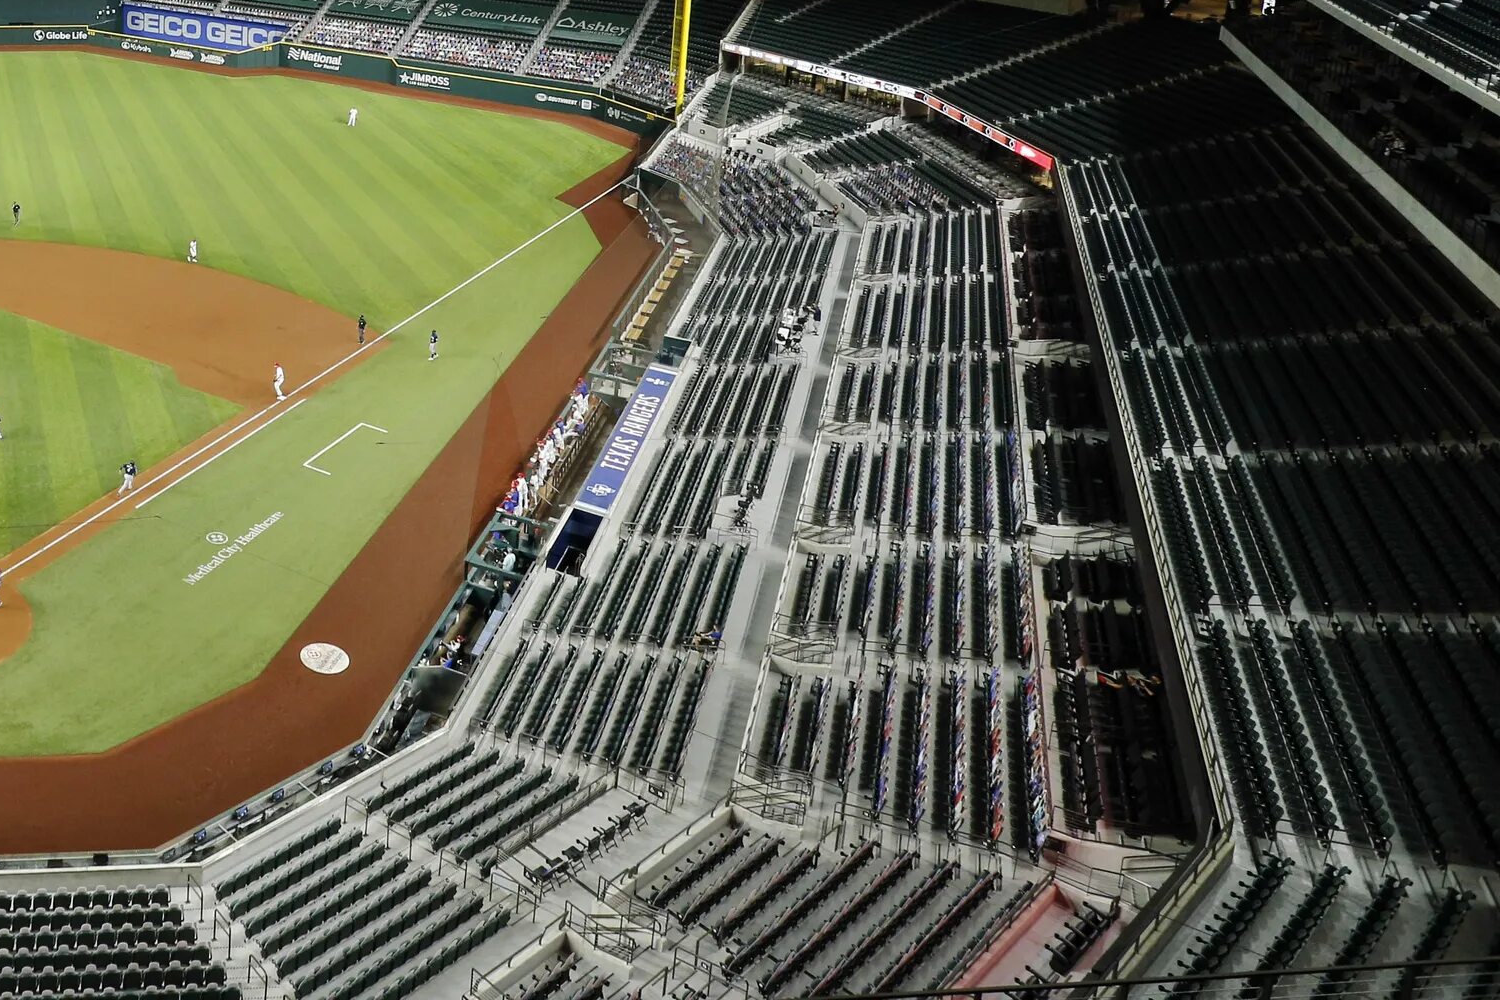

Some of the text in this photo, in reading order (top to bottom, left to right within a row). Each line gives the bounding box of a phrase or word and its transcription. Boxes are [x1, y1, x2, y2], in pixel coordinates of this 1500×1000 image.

[461, 8, 540, 25] CenturyLink
[127, 11, 201, 39] GEICO
[574, 20, 630, 35] Ashley
[46, 31, 88, 40] Globe Life
[300, 50, 341, 66] National
[322, 63, 340, 71] Rental
[600, 393, 661, 472] TEXAS RANGERS
[182, 511, 284, 586] Medical City Healthcare
